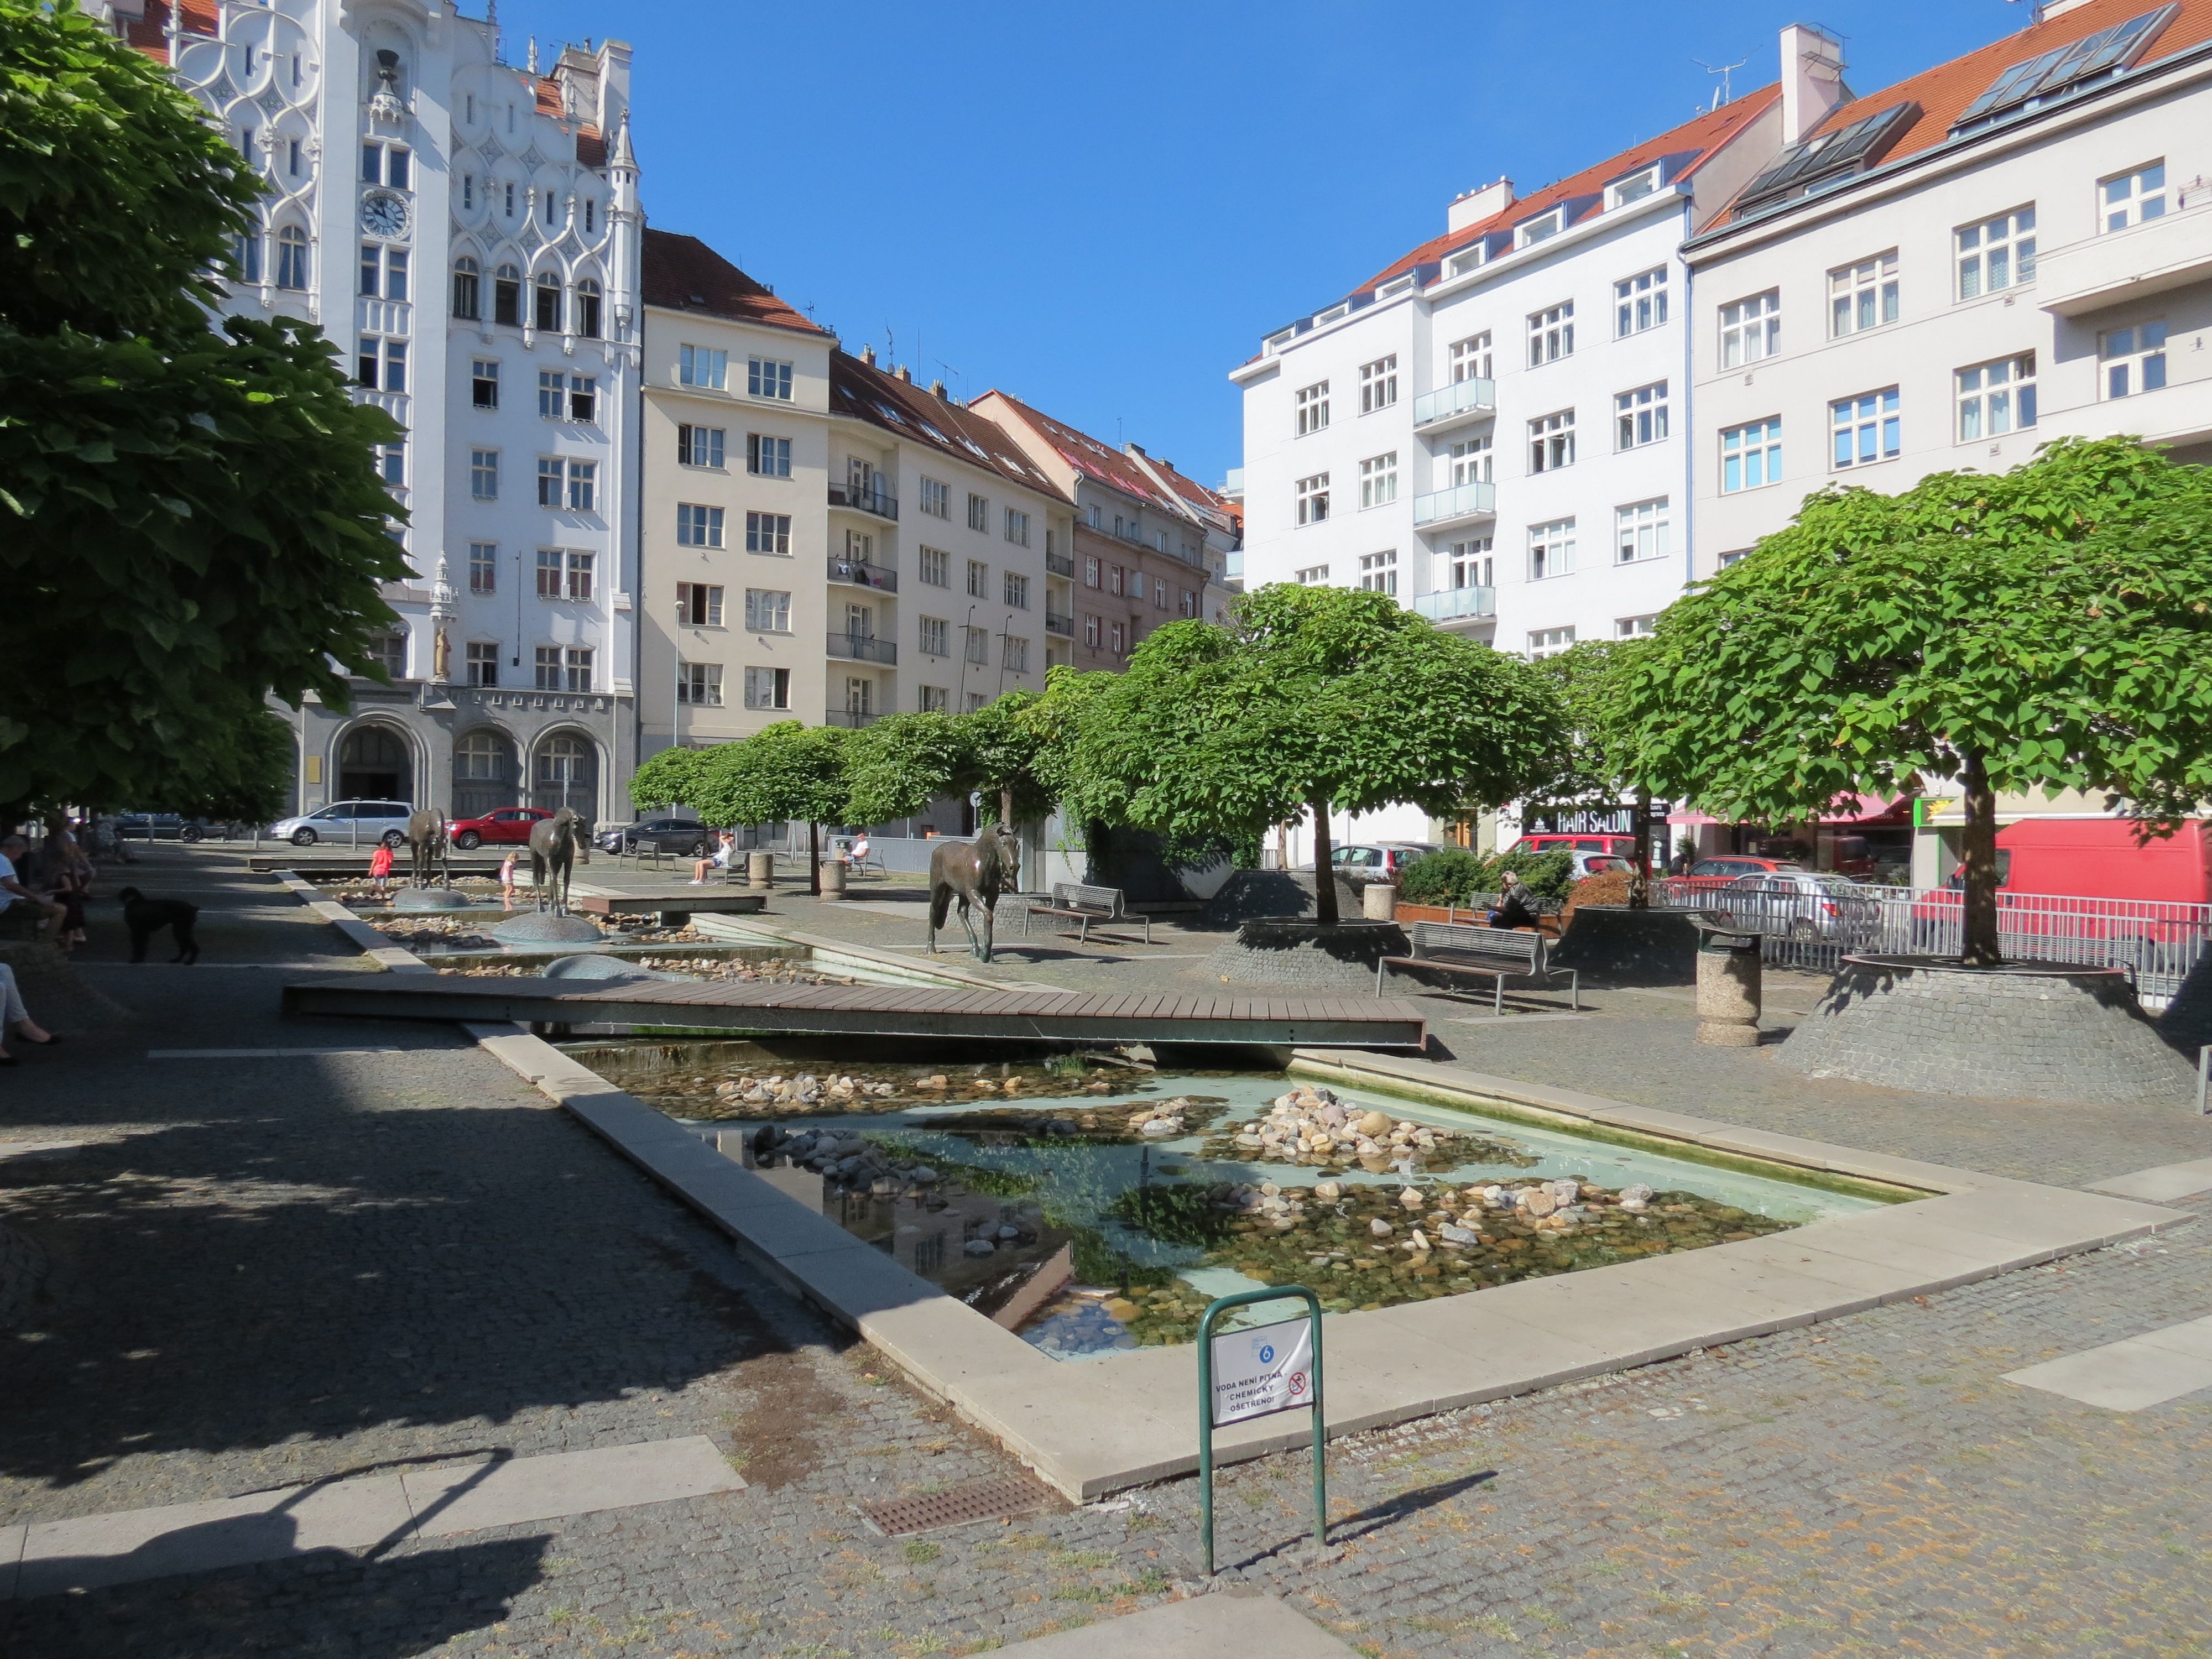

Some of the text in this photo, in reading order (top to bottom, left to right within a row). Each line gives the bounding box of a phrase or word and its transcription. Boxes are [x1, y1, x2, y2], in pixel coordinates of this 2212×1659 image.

[1557, 811, 1587, 832] HAIR
[1589, 810, 1631, 833] SALON
[1216, 1383, 1237, 1392] VODA
[1239, 1376, 1257, 1387] NENÍ
[1229, 1384, 1274, 1401] CHEMICKY
